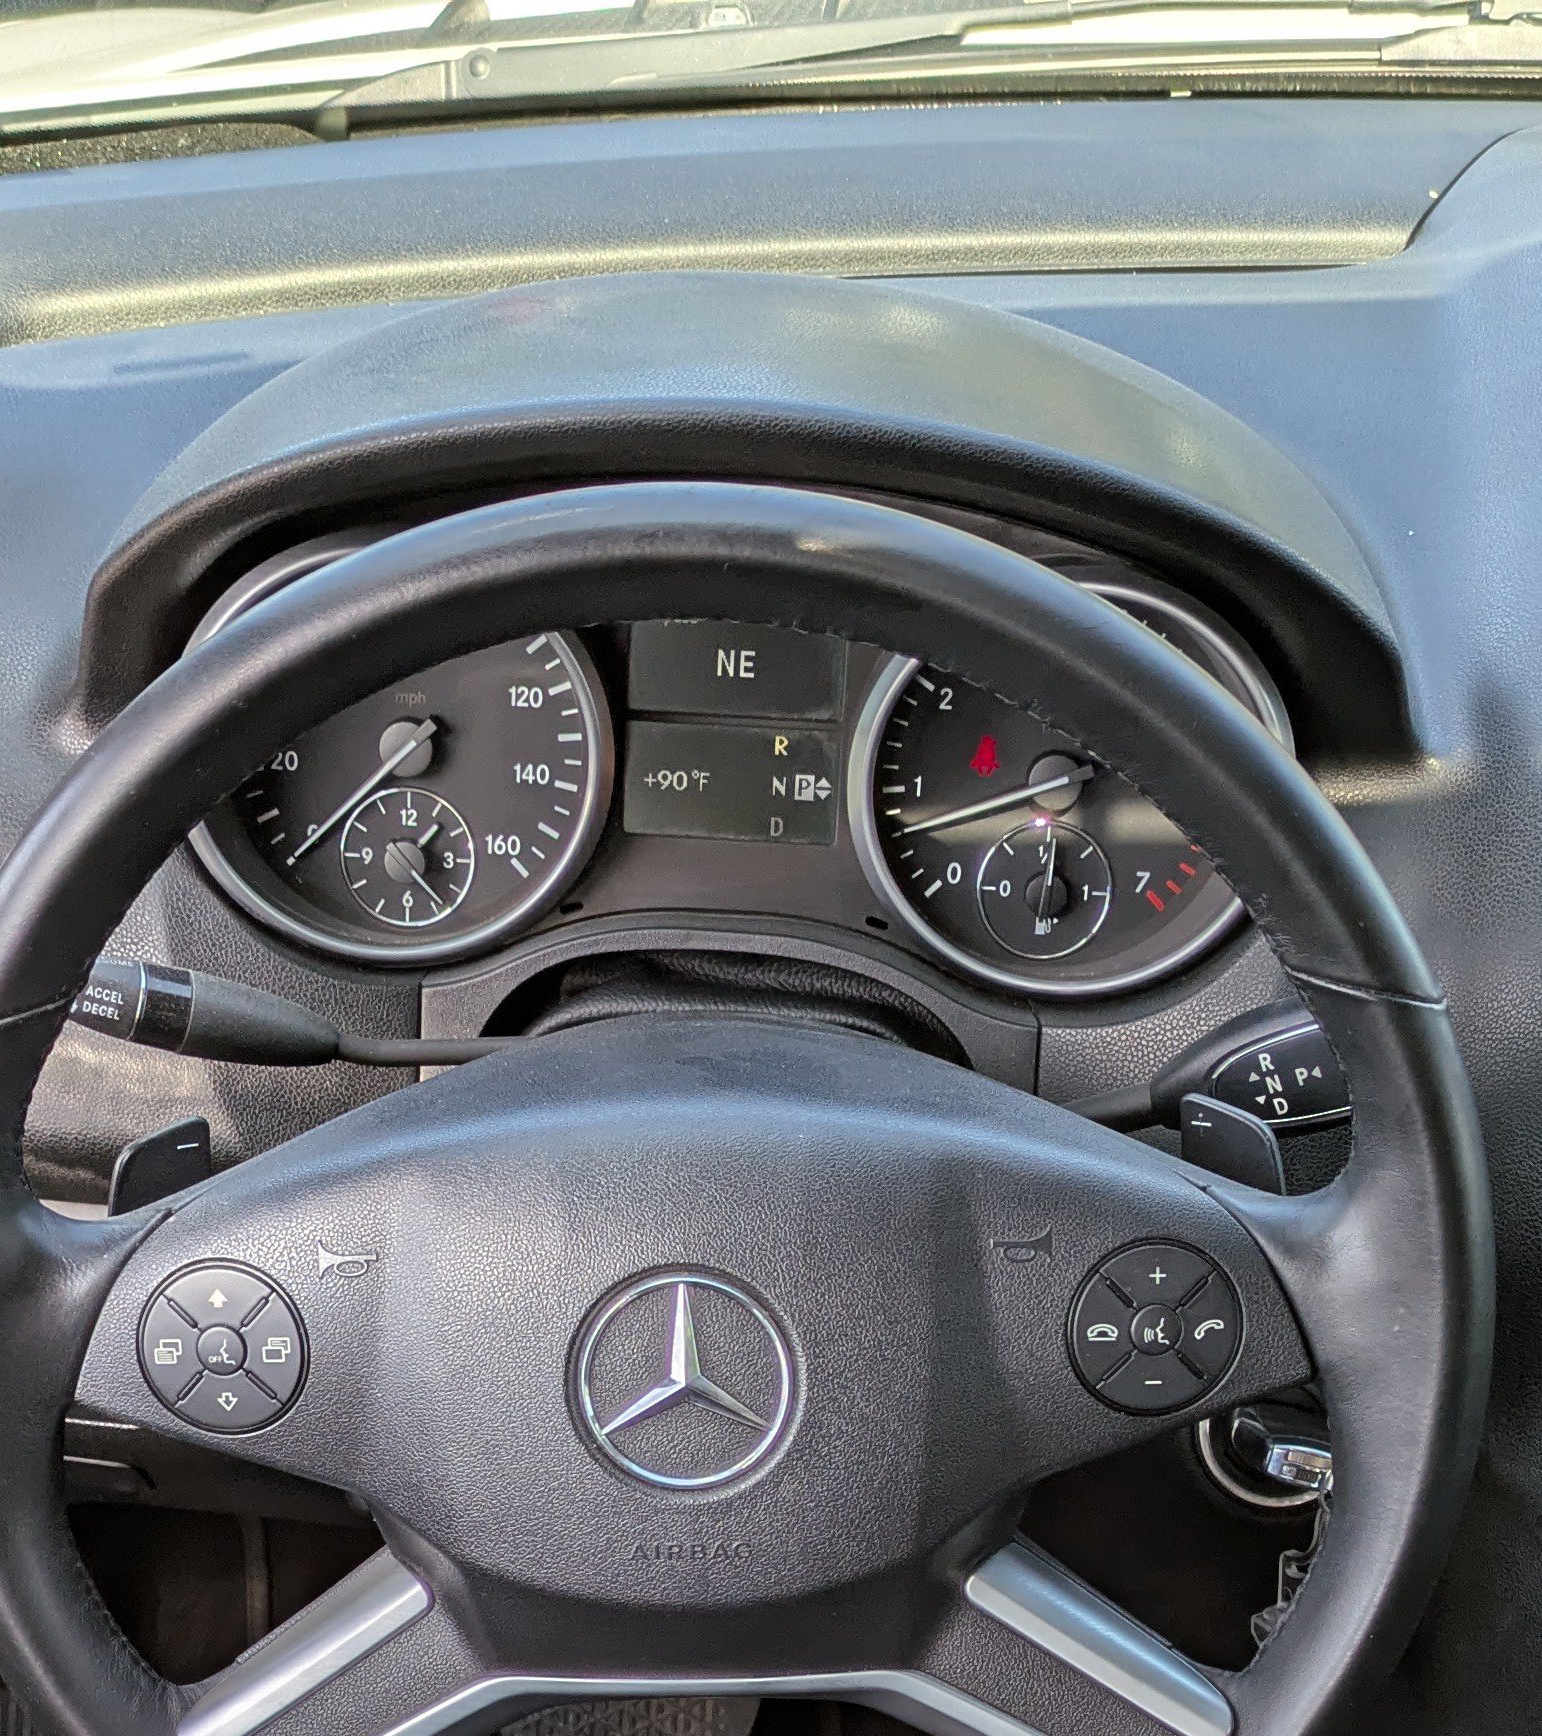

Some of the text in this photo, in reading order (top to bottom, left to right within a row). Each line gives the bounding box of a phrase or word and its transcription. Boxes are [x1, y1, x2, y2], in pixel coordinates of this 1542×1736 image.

[716, 649, 756, 679] NE
[394, 691, 427, 706] mph
[509, 686, 543, 708] 120
[939, 688, 953, 710] 2
[774, 735, 790, 756] R
[271, 751, 299, 771] 20
[513, 764, 550, 786] 140
[772, 776, 787, 797] N
[913, 775, 922, 797] 1
[400, 809, 417, 826] 12
[770, 816, 784, 837] D
[485, 834, 520, 856] 160
[362, 849, 373, 864] 9
[443, 852, 454, 868] 3
[947, 862, 962, 884] 0
[1135, 871, 1150, 893] 7
[999, 881, 1011, 897] 0
[1081, 885, 1090, 900] 1
[402, 891, 413, 908] 6
[85, 985, 124, 1005] ACCEL
[82, 1000, 120, 1020] DECEL
[1258, 1053, 1275, 1072] R
[1265, 1074, 1283, 1095] N
[1294, 1067, 1309, 1087] P
[1272, 1097, 1289, 1116] D
[630, 1542, 752, 1561] AIRBAG
